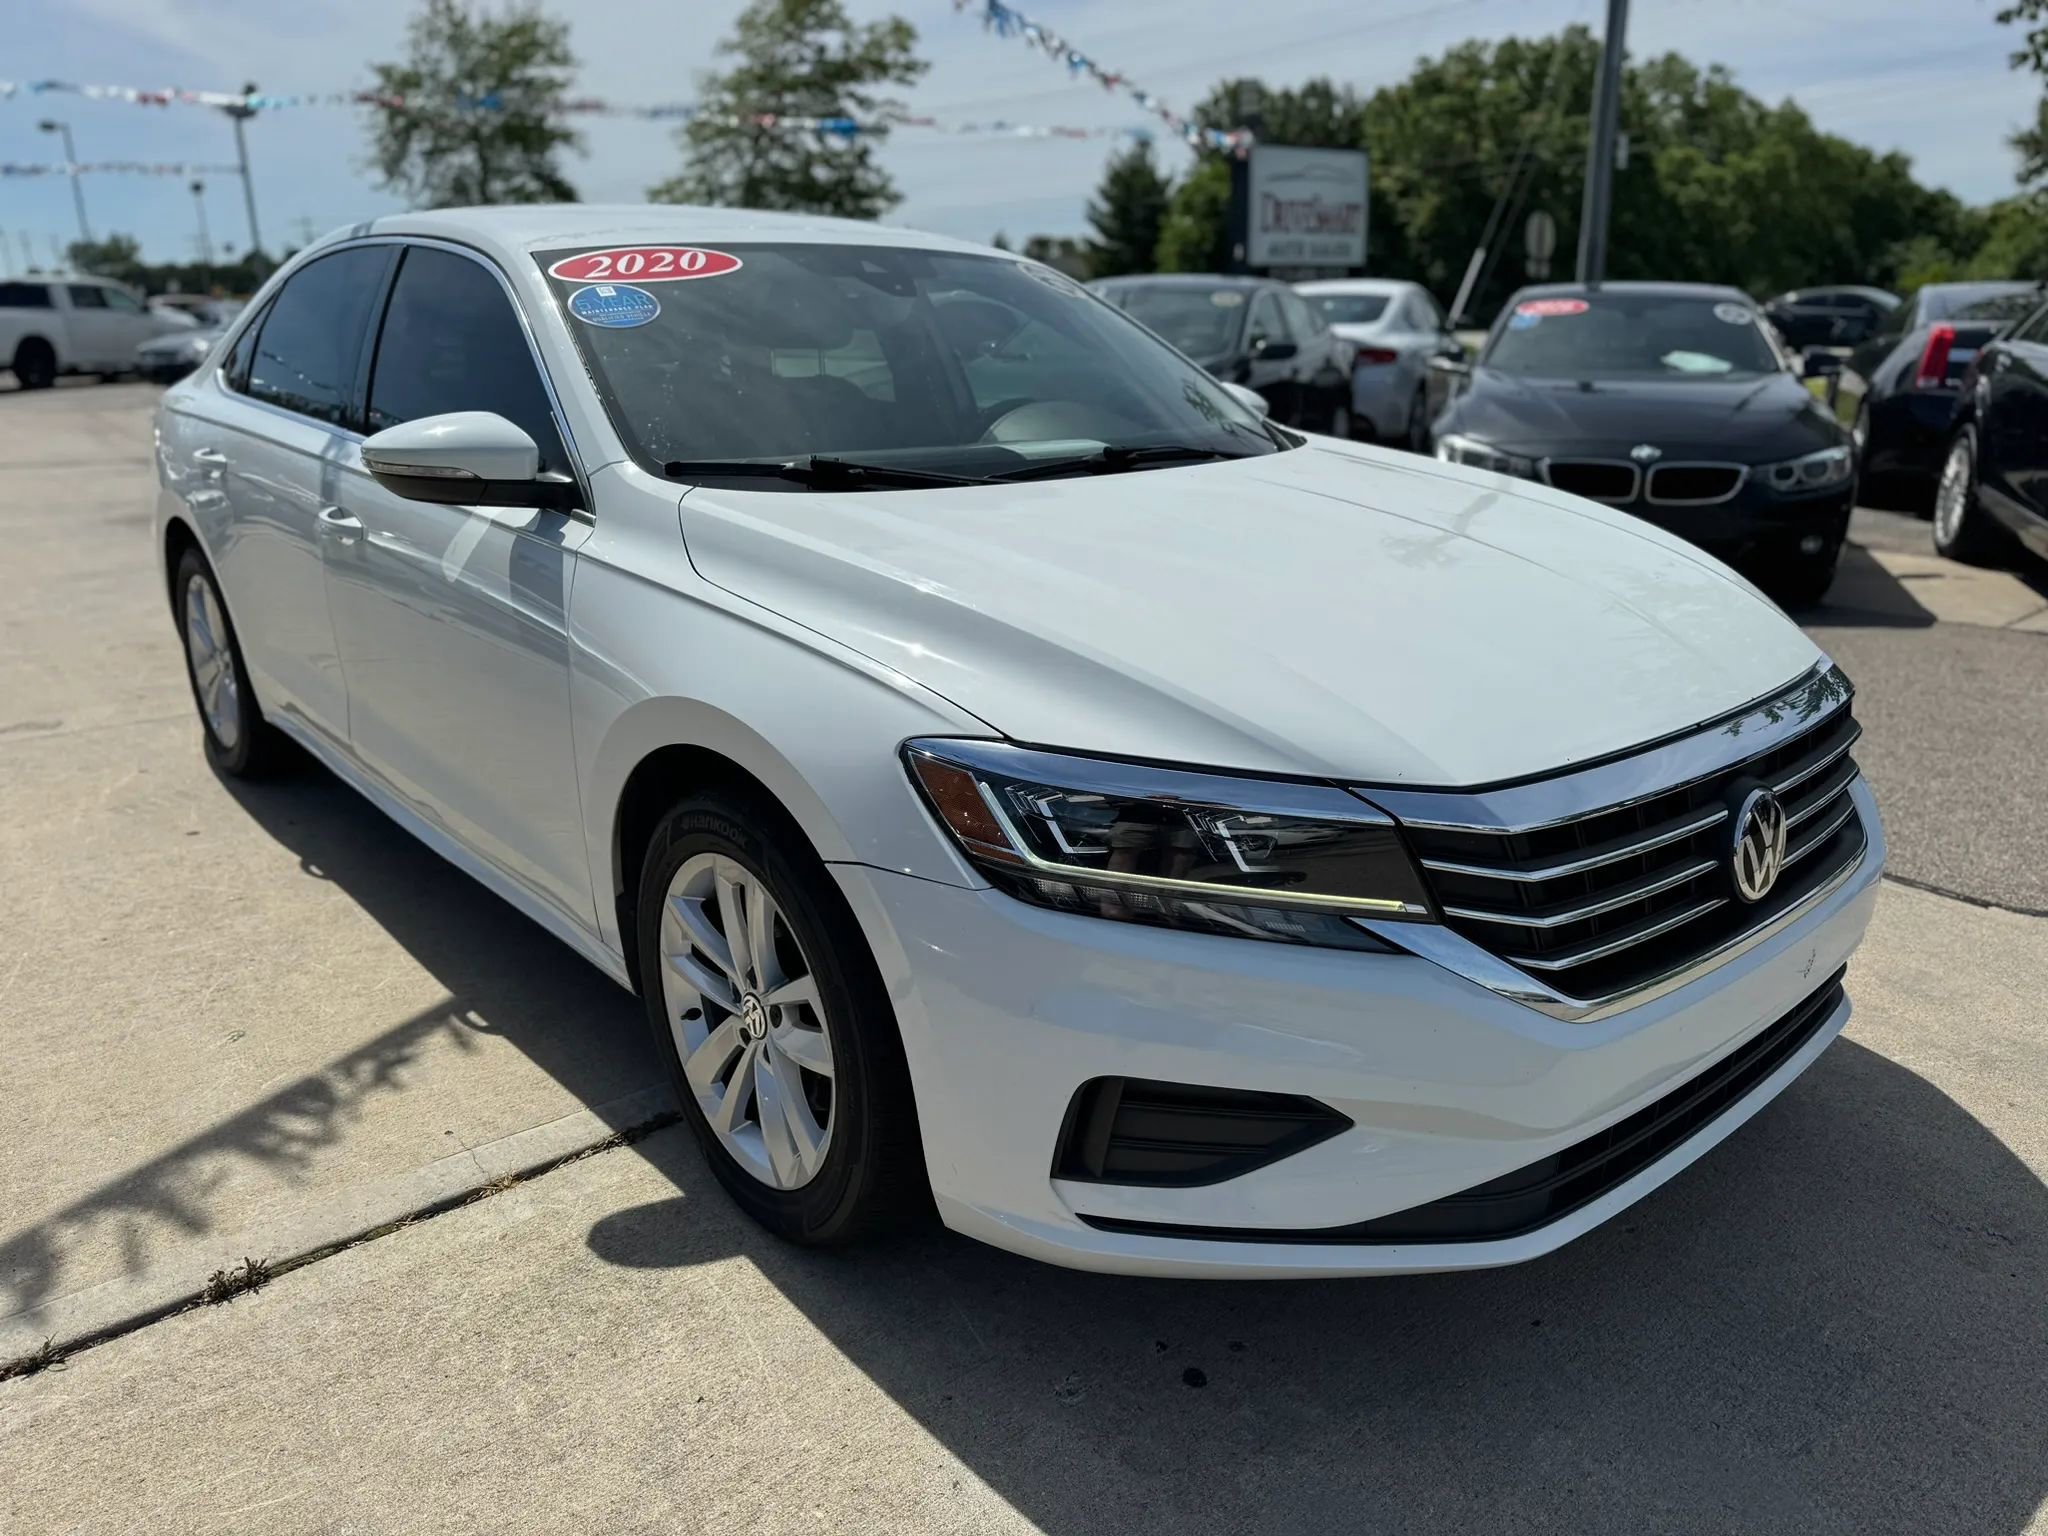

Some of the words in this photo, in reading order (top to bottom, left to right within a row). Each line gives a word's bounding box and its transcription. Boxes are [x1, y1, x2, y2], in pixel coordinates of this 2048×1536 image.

[584, 251, 706, 278] 2020
[575, 299, 591, 311] 5
[593, 294, 650, 308] YEAR
